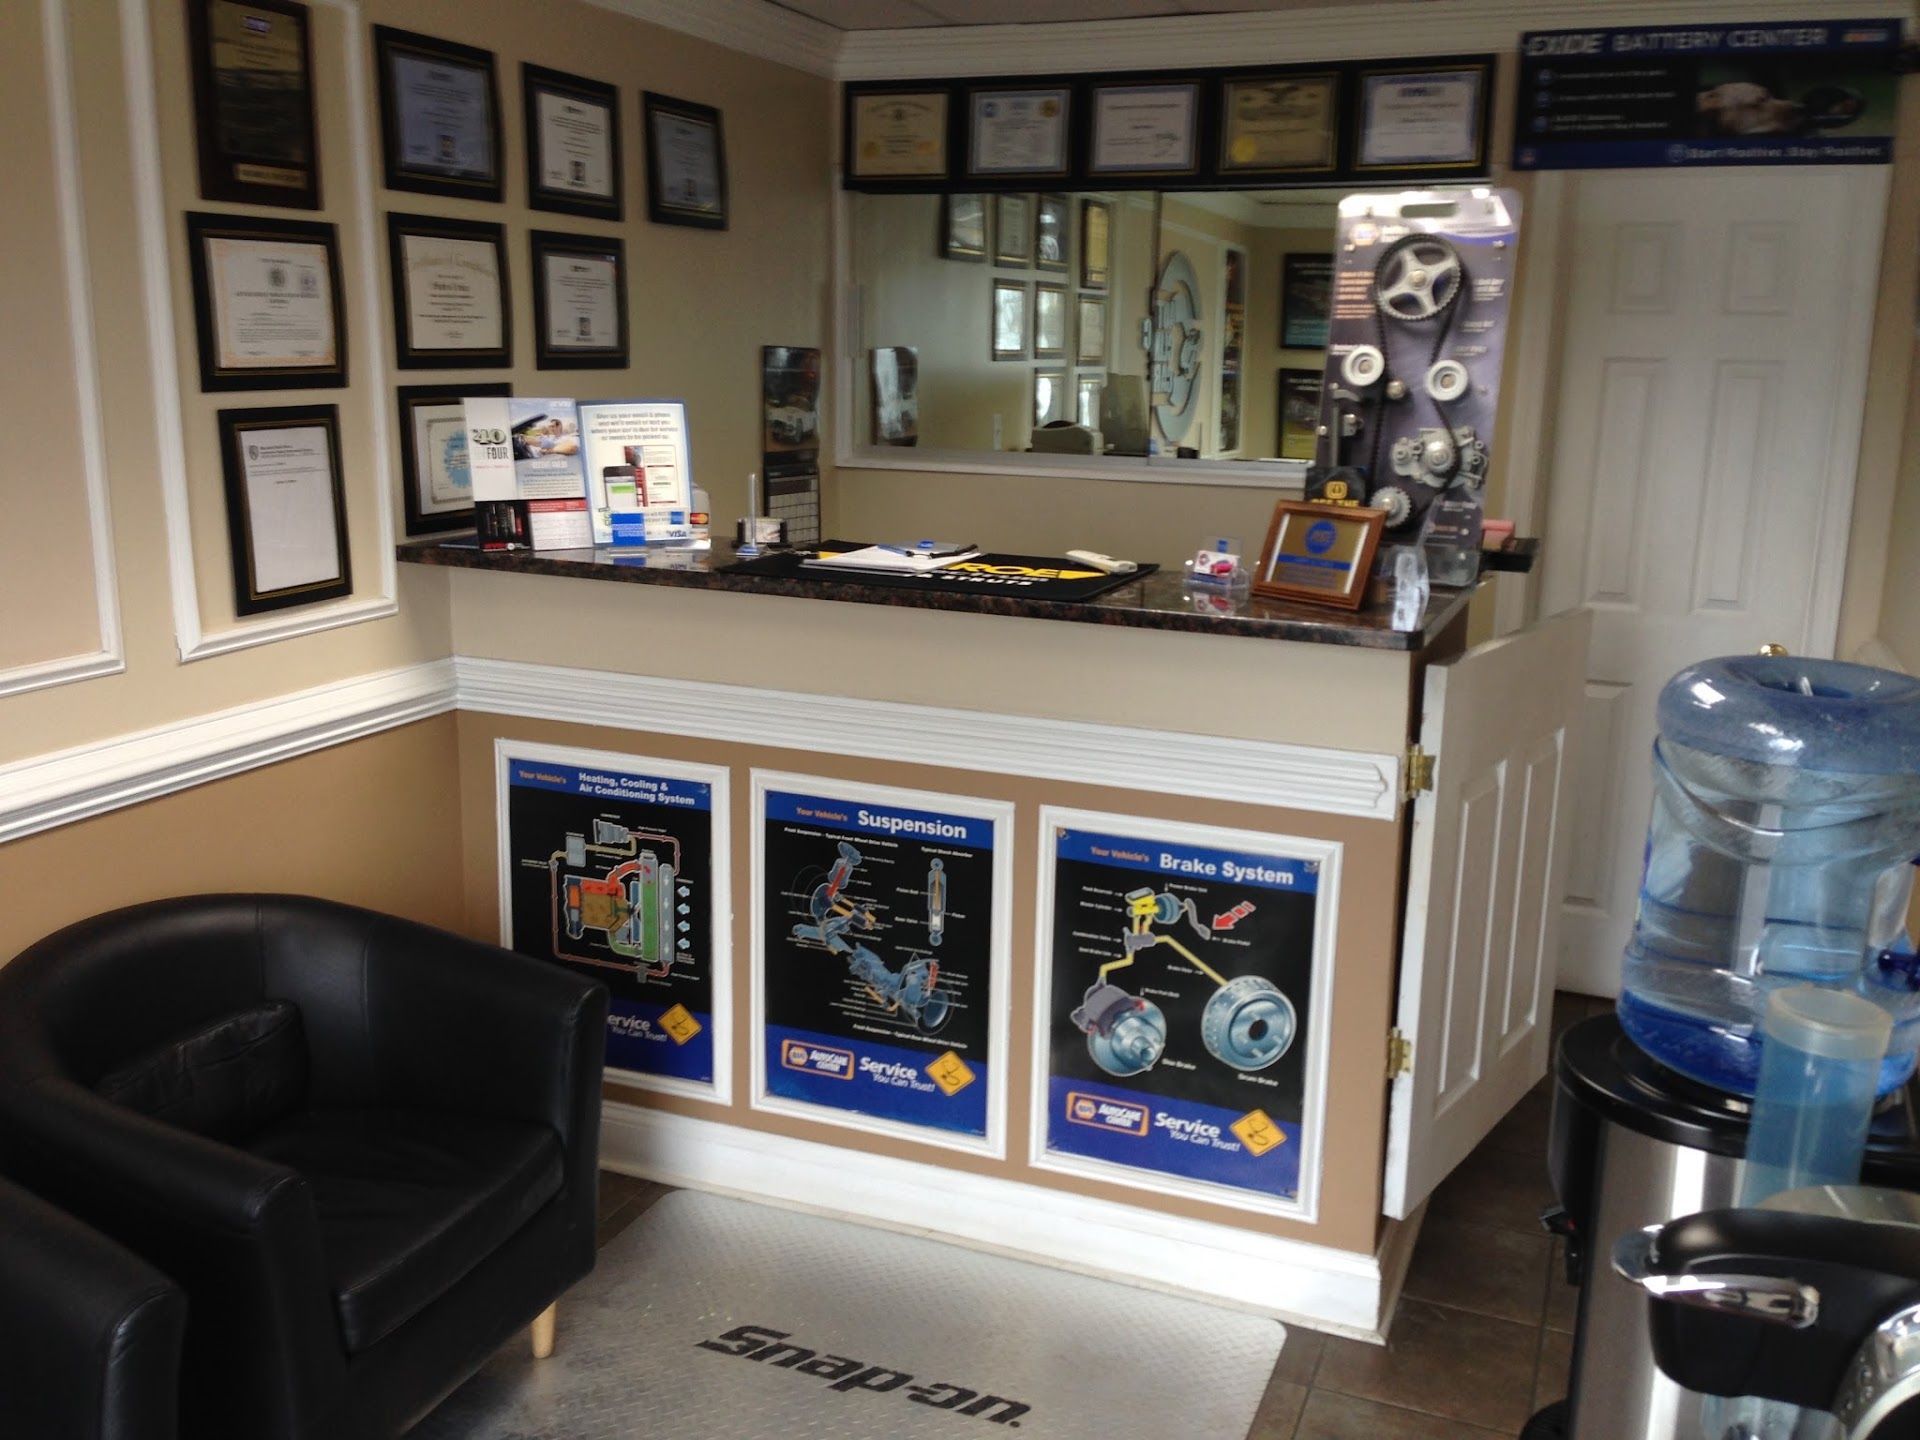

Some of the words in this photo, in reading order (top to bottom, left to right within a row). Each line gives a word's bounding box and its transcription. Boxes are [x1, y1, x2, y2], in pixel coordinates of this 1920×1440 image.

[1612, 31, 1722, 51] BATTERY
[1728, 28, 1829, 47] CENTER
[487, 446, 509, 460] FOUR
[945, 562, 1059, 578] ROE
[579, 772, 618, 788] Heating,
[620, 777, 657, 791] Cooling
[659, 782, 668, 791] &
[579, 782, 593, 793] Air
[594, 785, 656, 803] Conditioning
[657, 792, 695, 806] System
[857, 809, 967, 839] Suspension
[1159, 853, 1217, 876] Brake
[1222, 860, 1294, 885] System
[608, 1014, 651, 1031] ervice
[859, 1056, 918, 1080] Service
[872, 1072, 890, 1084] You
[891, 1076, 908, 1088] Can
[910, 1079, 936, 1093] Trust!
[1154, 1111, 1221, 1138] Service
[1169, 1129, 1189, 1142] You
[1190, 1133, 1210, 1147] Can
[1211, 1136, 1241, 1153] Trust!
